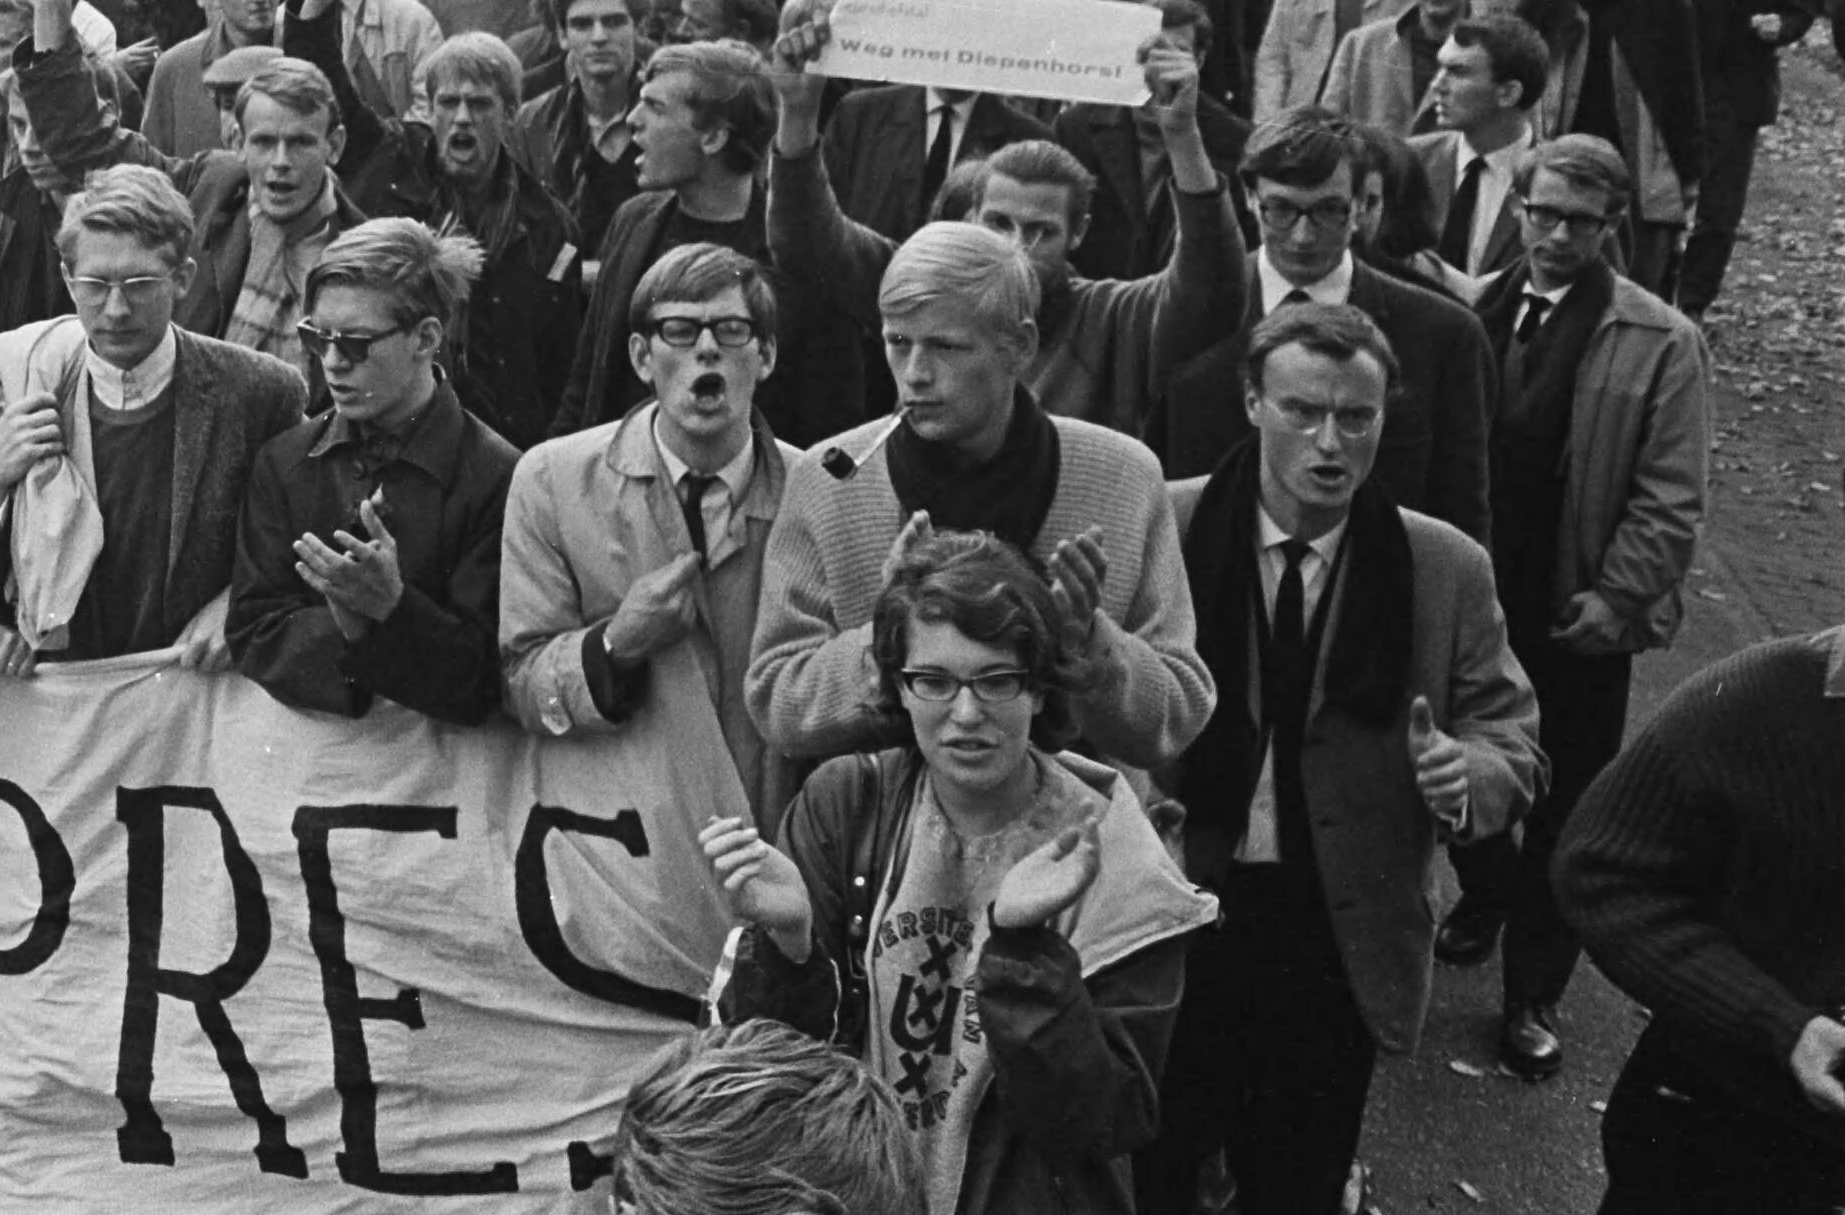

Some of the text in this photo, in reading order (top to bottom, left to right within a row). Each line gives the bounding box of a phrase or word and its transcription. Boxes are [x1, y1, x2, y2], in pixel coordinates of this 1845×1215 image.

[840, 38, 1124, 78] Weg met Diepenhorst
